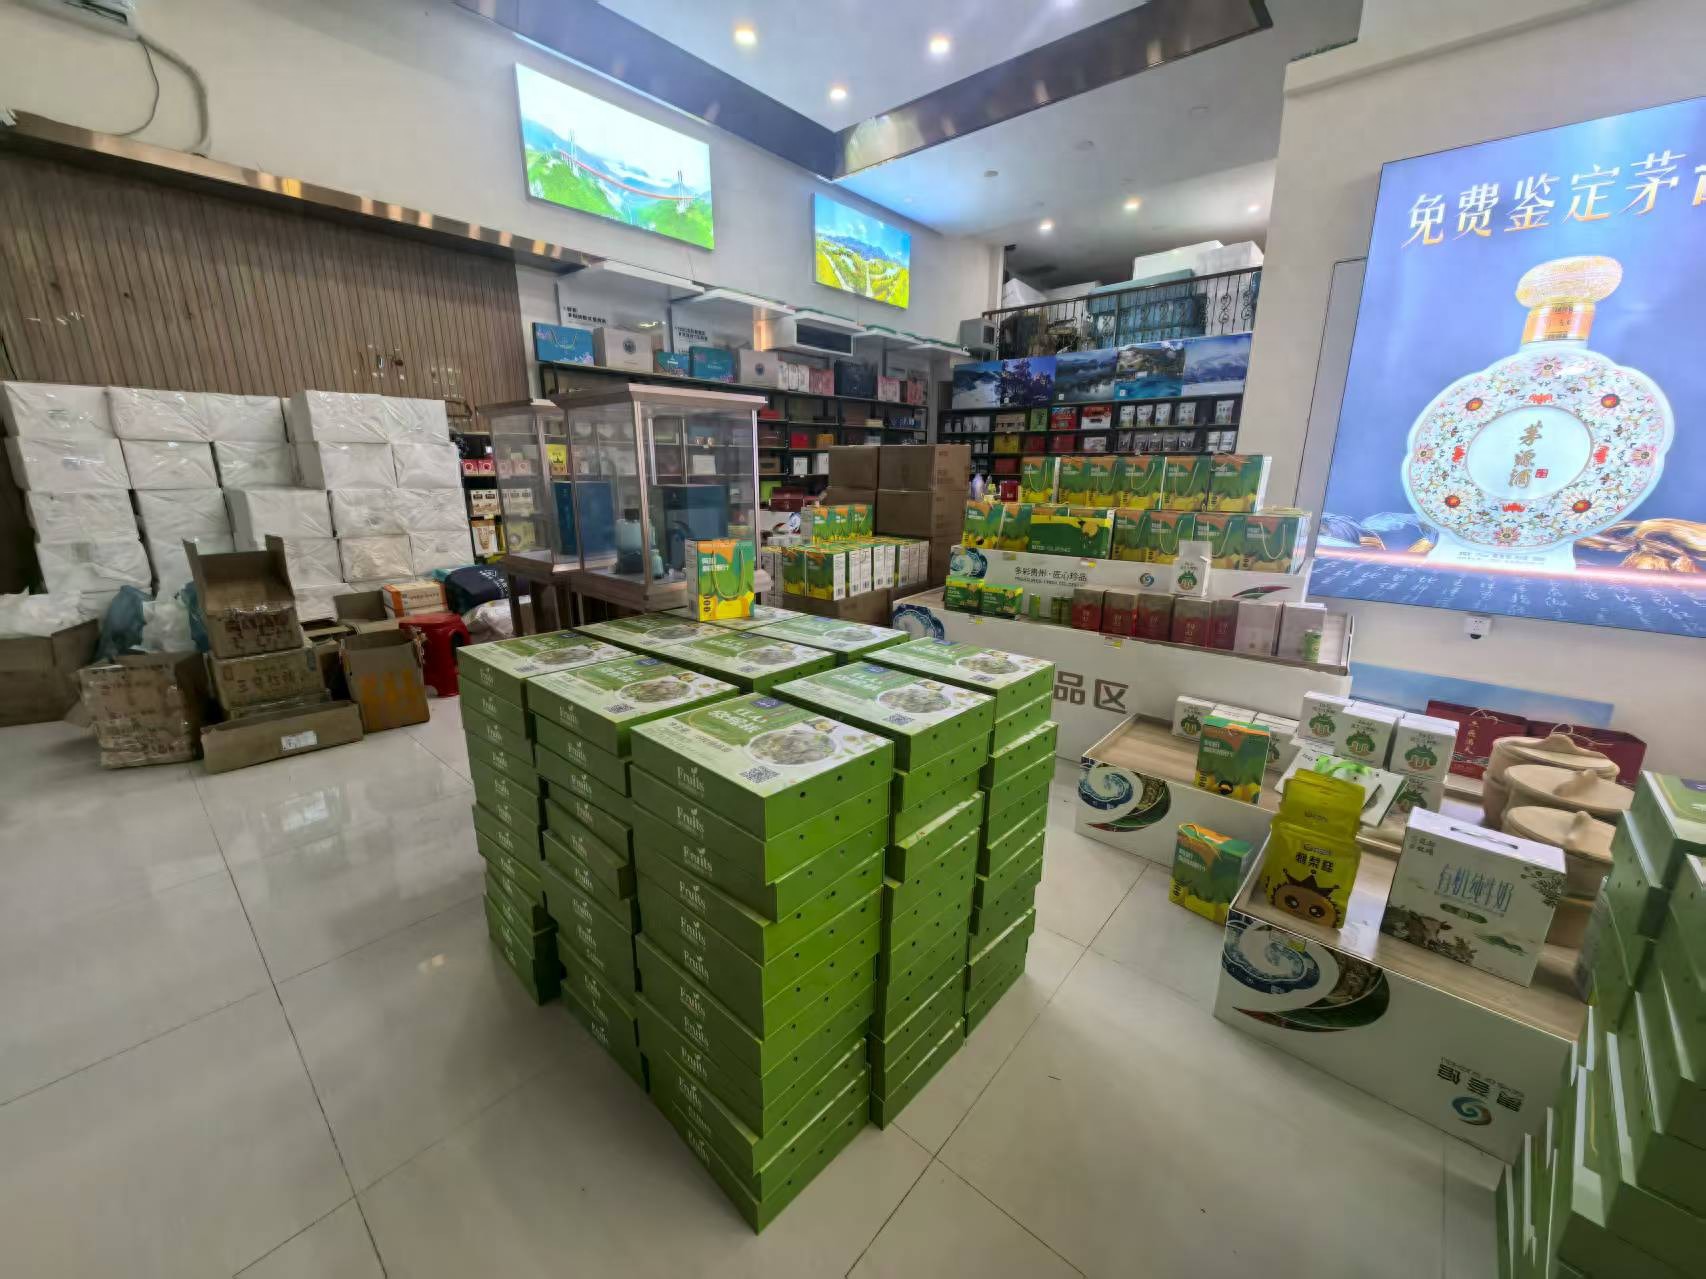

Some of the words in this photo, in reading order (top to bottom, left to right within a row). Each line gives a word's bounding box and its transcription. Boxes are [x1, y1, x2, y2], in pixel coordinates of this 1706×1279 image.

[1053, 671, 1129, 714] 品区
[571, 774, 593, 796] Fruits
[677, 766, 705, 793] Fruits
[677, 806, 705, 833] Fruits
[683, 846, 713, 872] Fruits
[679, 881, 706, 910] Fruits
[680, 916, 706, 946] Fruits
[683, 950, 709, 979] Fruits
